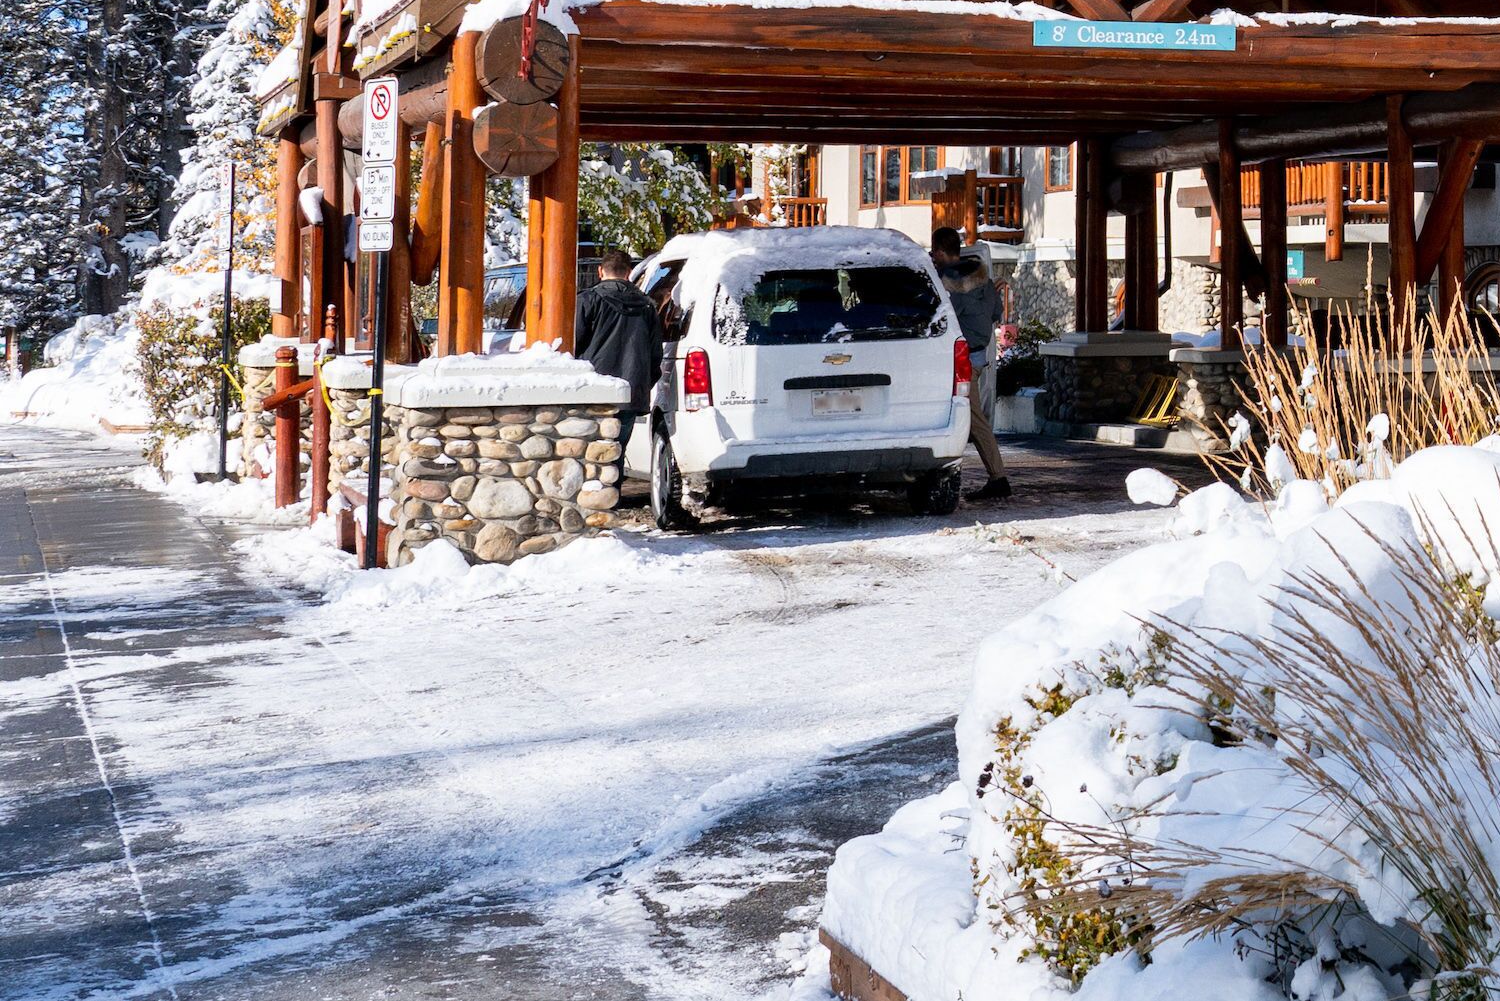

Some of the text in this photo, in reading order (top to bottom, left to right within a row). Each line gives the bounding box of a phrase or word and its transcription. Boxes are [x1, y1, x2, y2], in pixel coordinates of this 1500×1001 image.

[1077, 25, 1165, 44] Clearance
[1175, 28, 1217, 45] 2.4m
[370, 122, 389, 130] BUSES
[372, 131, 386, 139] ONLY
[367, 171, 376, 184] 15
[371, 196, 383, 205] ZONE
[363, 231, 389, 241] NO IDLING
